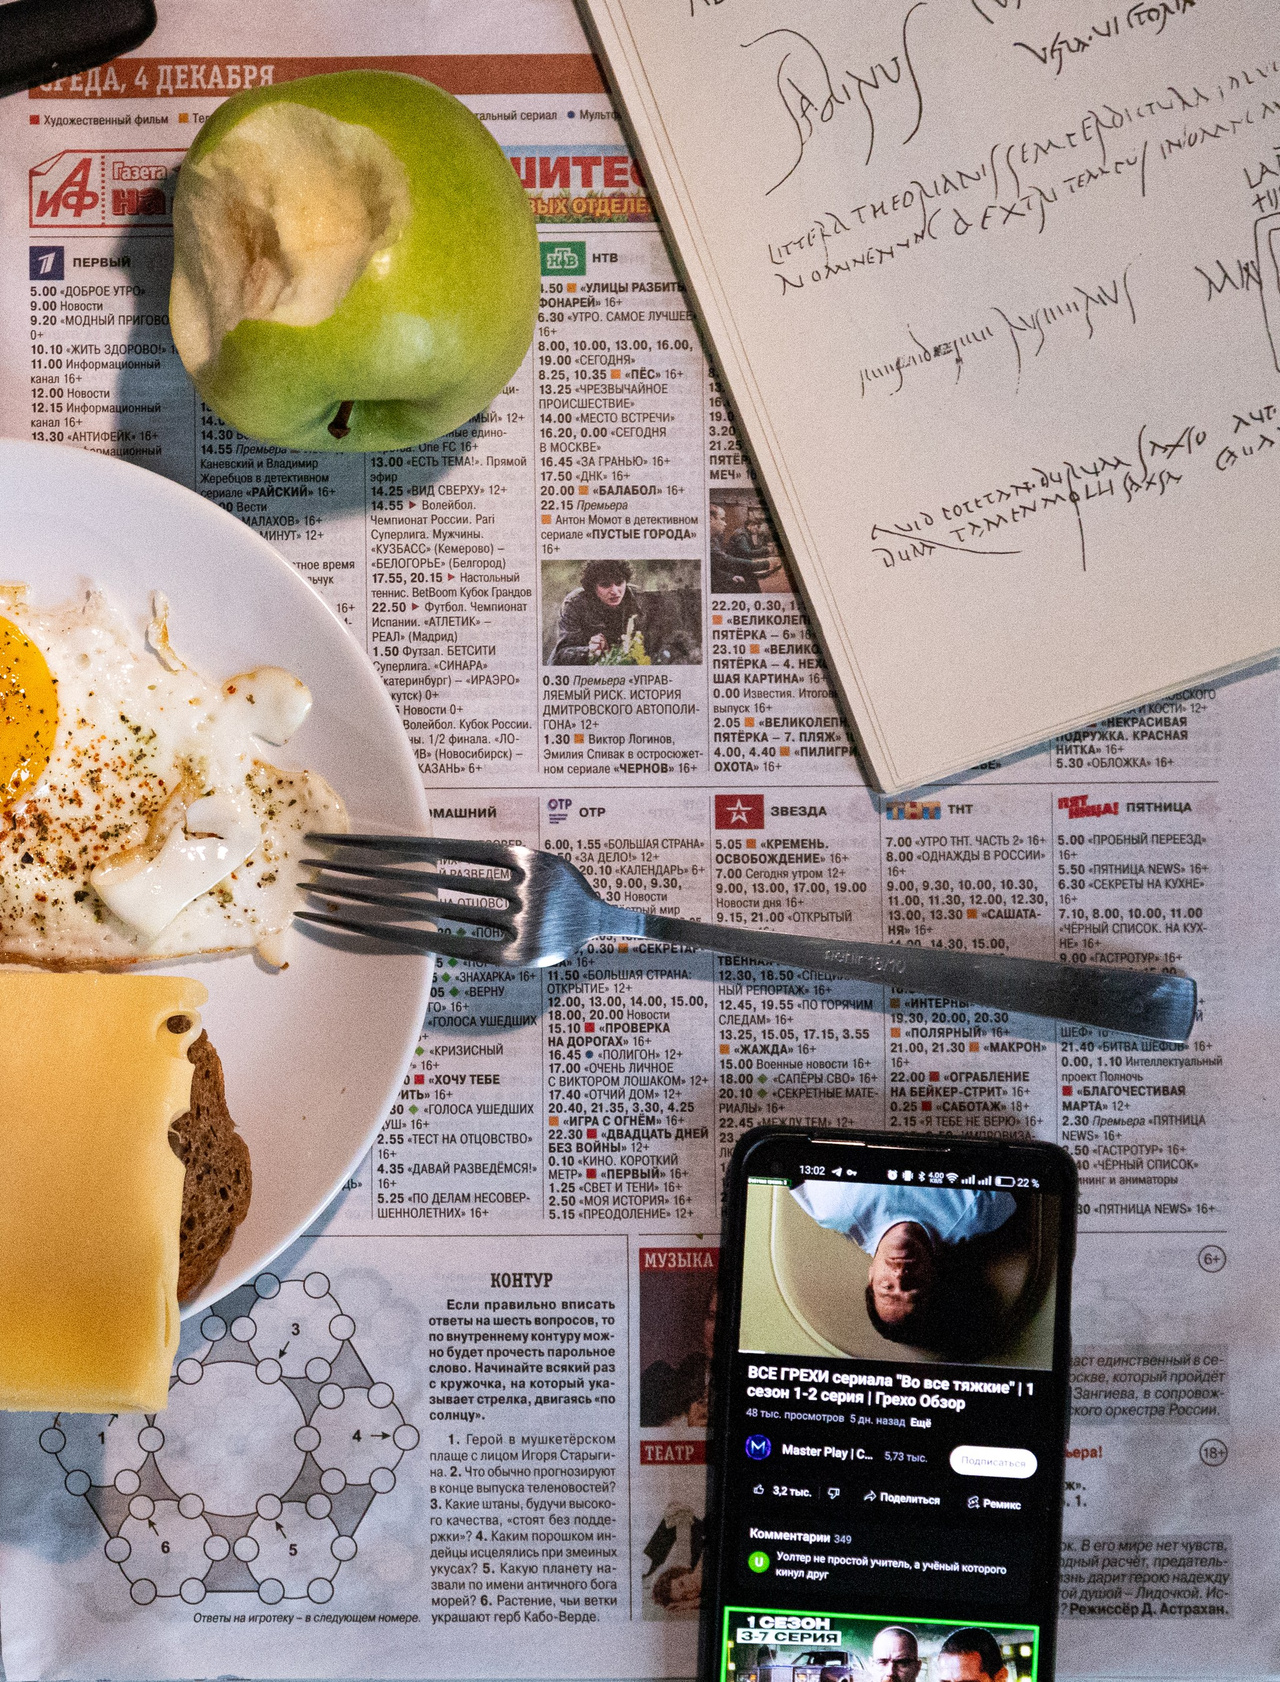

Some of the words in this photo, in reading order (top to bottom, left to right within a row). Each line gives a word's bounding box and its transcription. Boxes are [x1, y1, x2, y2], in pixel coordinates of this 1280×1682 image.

[135, 66, 148, 90] 4
[157, 65, 274, 94] ДЕКАБРЯ
[45, 115, 132, 126] Художественный
[134, 116, 168, 126] фильм
[113, 161, 170, 183] Газета
[73, 258, 131, 267] ПЕРВЫЙ
[593, 253, 618, 262] НТВ
[30, 287, 56, 296] 5.00
[60, 286, 110, 296] «ДОБРОЕ
[113, 286, 145, 296] УТРО»
[31, 301, 57, 311] 9.00
[61, 302, 103, 310] Новости
[540, 384, 571, 394] 13.25
[575, 383, 667, 394] «ЧРЕЗВЫЧАЙНОЕ
[539, 398, 634, 409] ПРОИСШЕСТВИЕ»
[371, 529, 428, 541] Суперлига.
[433, 529, 484, 541] Мужчины.
[541, 531, 583, 541] сериале
[587, 529, 639, 539] «ПУСТЫЕ
[644, 529, 696, 540] ГОРОДА»
[372, 558, 445, 569] «БЕЛОГОРЬЕ»
[449, 558, 506, 569] (Белгород)
[412, 587, 457, 597] BetBoom
[614, 763, 674, 773] «ЧЕРНОВ»
[579, 808, 605, 817] ОТР
[771, 807, 826, 817] ЗВЕЗДА
[949, 804, 972, 813] ТНТ
[1127, 803, 1192, 813] ПЯТНИЦА
[1089, 879, 1144, 889] «СЕКРЕТЫ
[1147, 879, 1161, 888] НА
[1165, 878, 1204, 888] КУХНЕ»
[735, 1044, 793, 1055] «ЖАЖДА»
[800, 1166, 825, 1175] 13:02
[1018, 1178, 1029, 1187] 22
[645, 1253, 712, 1268] МУЗЫКА
[1204, 1253, 1219, 1265] 6+
[491, 1273, 552, 1288] КОНТУР
[292, 1323, 300, 1335] 3
[749, 1366, 777, 1379] ВСЕ
[781, 1368, 829, 1382] ГРЕХИ
[832, 1374, 892, 1387] сериала
[896, 1374, 920, 1388] "Во
[924, 1379, 949, 1390] все
[953, 1381, 1015, 1394] тяжкие"
[1027, 1383, 1033, 1395] 1
[747, 1387, 789, 1398] сезон
[794, 1387, 817, 1400] 1-2
[821, 1391, 864, 1405] серия
[876, 1392, 916, 1407] Грехо
[920, 1394, 965, 1412] Обзор
[430, 1412, 485, 1422] солнцу».
[761, 1410, 781, 1418] тыс.
[784, 1412, 844, 1423] просмотров
[851, 1414, 855, 1423] 5
[858, 1416, 873, 1424] дн.
[876, 1418, 905, 1427] назад
[911, 1418, 931, 1428] Ещё
[353, 1430, 361, 1441] 4
[645, 1445, 694, 1460] ТЕАТР
[782, 1444, 821, 1456] Master
[824, 1447, 848, 1460] Play
[885, 1451, 904, 1461] 5,73
[907, 1454, 928, 1462] тыс.
[1204, 1446, 1226, 1459] 18+
[774, 1486, 787, 1496] 3,2
[880, 1492, 940, 1504] Поделиться
[983, 1499, 1021, 1509] Ремикс
[750, 1528, 830, 1543] Комментарии
[835, 1535, 851, 1543] 349
[777, 1552, 811, 1563] Уолтер
[828, 1556, 868, 1565] простой
[871, 1559, 912, 1569] учитель,
[922, 1561, 959, 1571] учёный
[962, 1565, 1007, 1574] которого
[776, 1569, 804, 1579] кинул
[806, 1571, 828, 1580] друг
[1070, 1603, 1138, 1616] Режиссёр
[1142, 1604, 1157, 1616] Д.
[1160, 1603, 1228, 1616] Астрахан.
[194, 1613, 231, 1623] Ответы
[248, 1614, 294, 1624] игротеку
[315, 1614, 376, 1624] следующем
[378, 1615, 421, 1623] номере.
[432, 1614, 490, 1624] украшают
[494, 1611, 521, 1623] герб
[524, 1611, 599, 1623] Кабо-Верде.
[747, 1617, 755, 1628] 1
[759, 1617, 830, 1630] СЕЗОН
[742, 1631, 768, 1641] 3-7
[775, 1632, 837, 1642] СЕРИЯ
